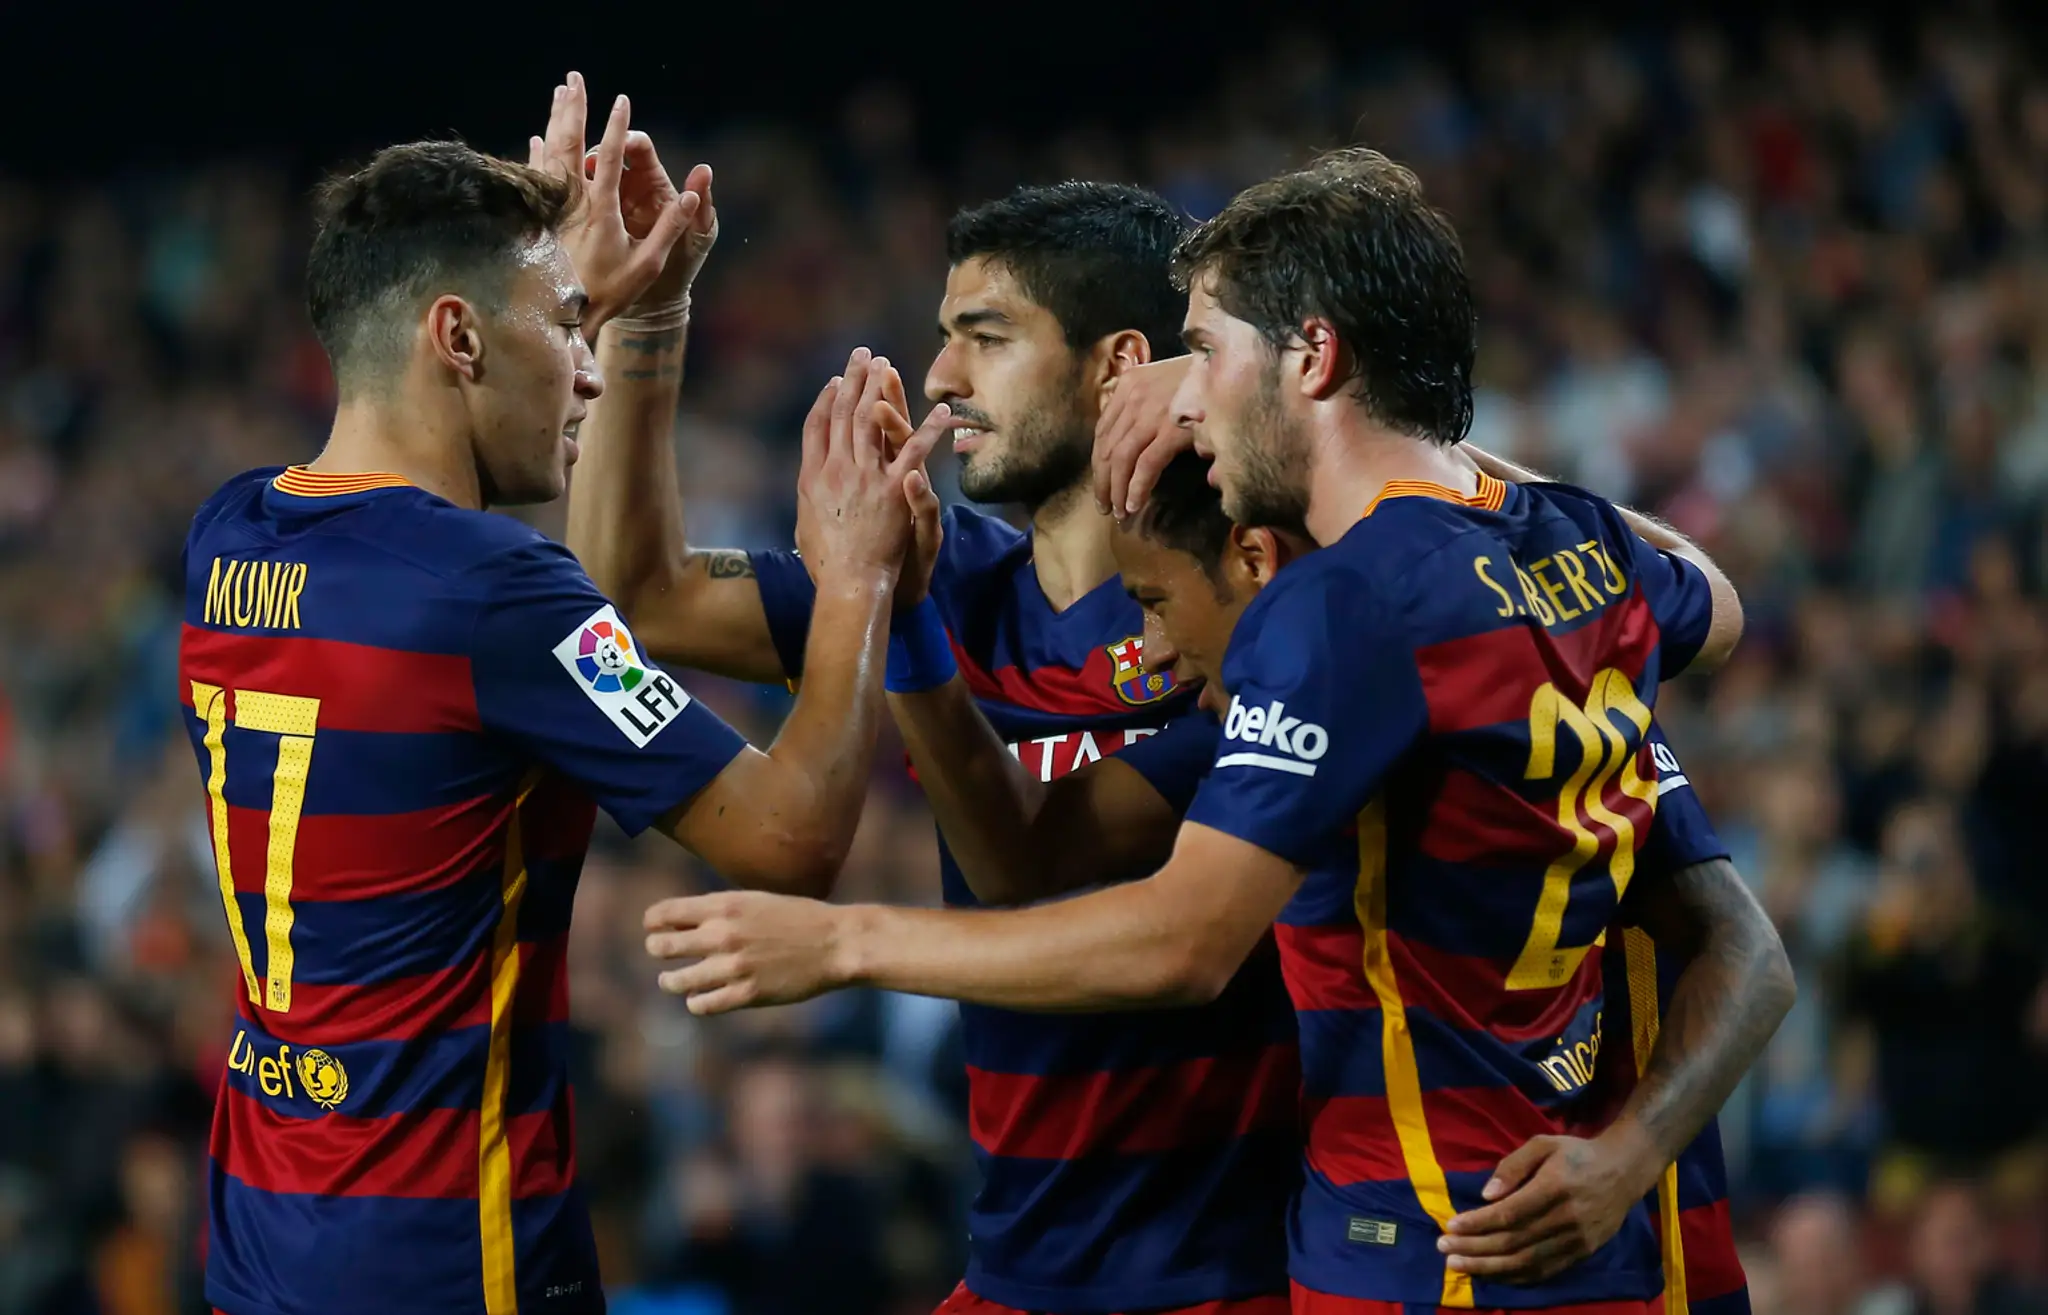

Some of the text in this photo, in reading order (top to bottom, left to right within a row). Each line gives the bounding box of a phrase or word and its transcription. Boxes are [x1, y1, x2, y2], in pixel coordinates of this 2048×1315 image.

[203, 556, 307, 630] MUNIR
[620, 674, 680, 738] LFP
[1223, 694, 1330, 761] beko
[189, 678, 322, 1014] 17
[1505, 667, 1660, 991] 20
